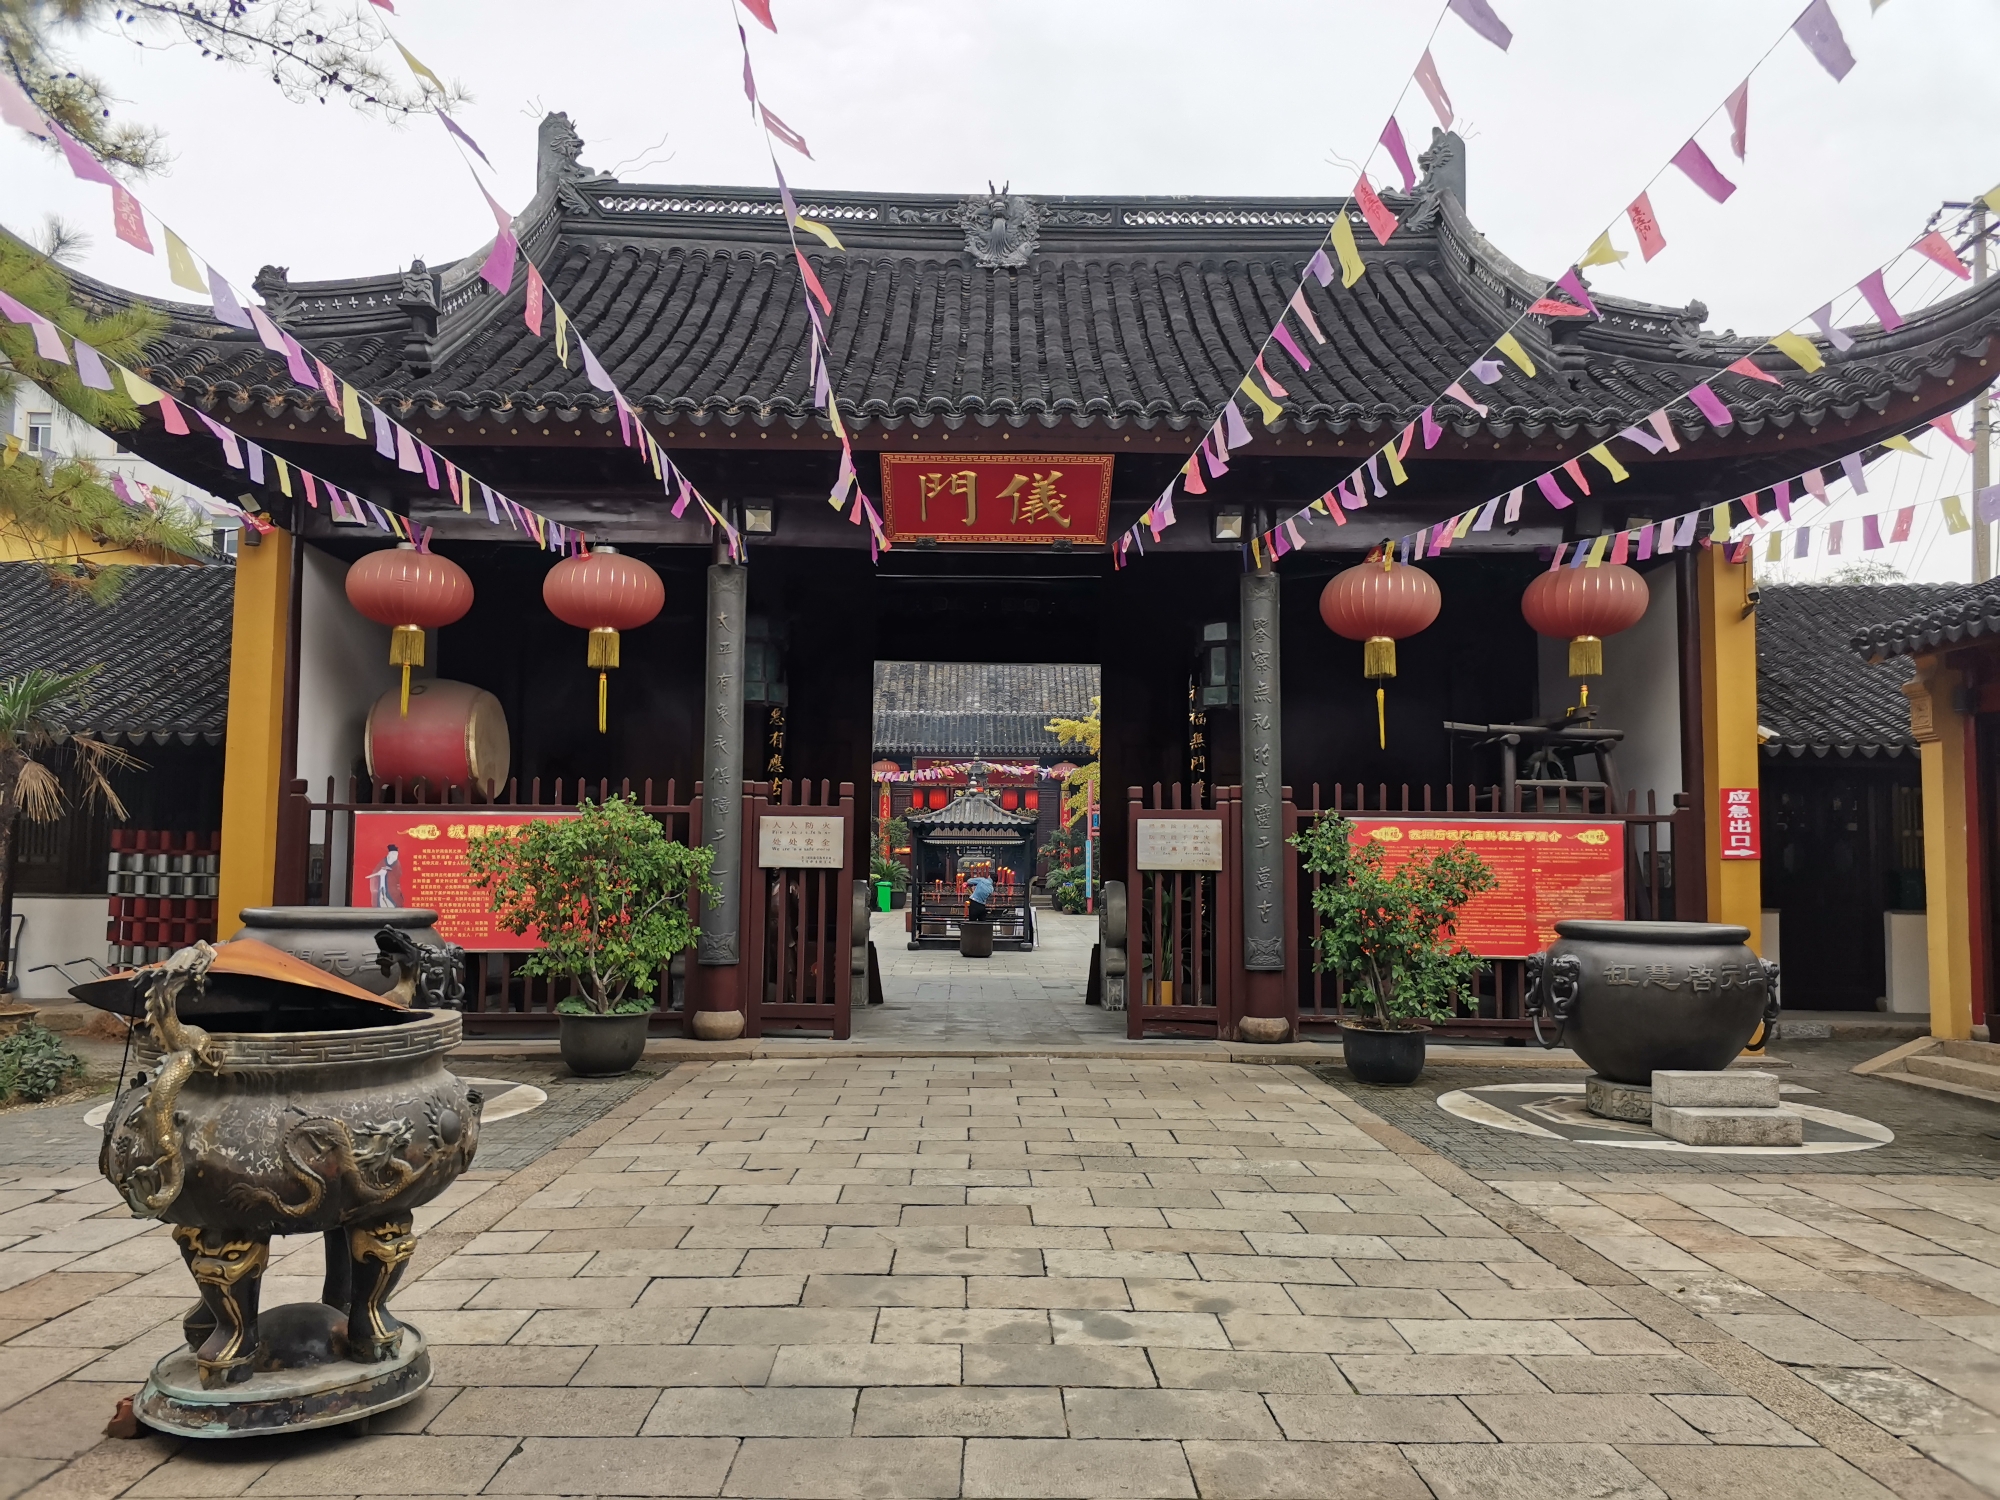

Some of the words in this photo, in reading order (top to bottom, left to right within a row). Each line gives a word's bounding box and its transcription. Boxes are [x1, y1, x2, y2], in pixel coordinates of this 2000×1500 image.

[1727, 789, 1752, 847] 应急出口
[772, 821, 831, 829] 人人防火
[772, 838, 831, 846] 处处安全
